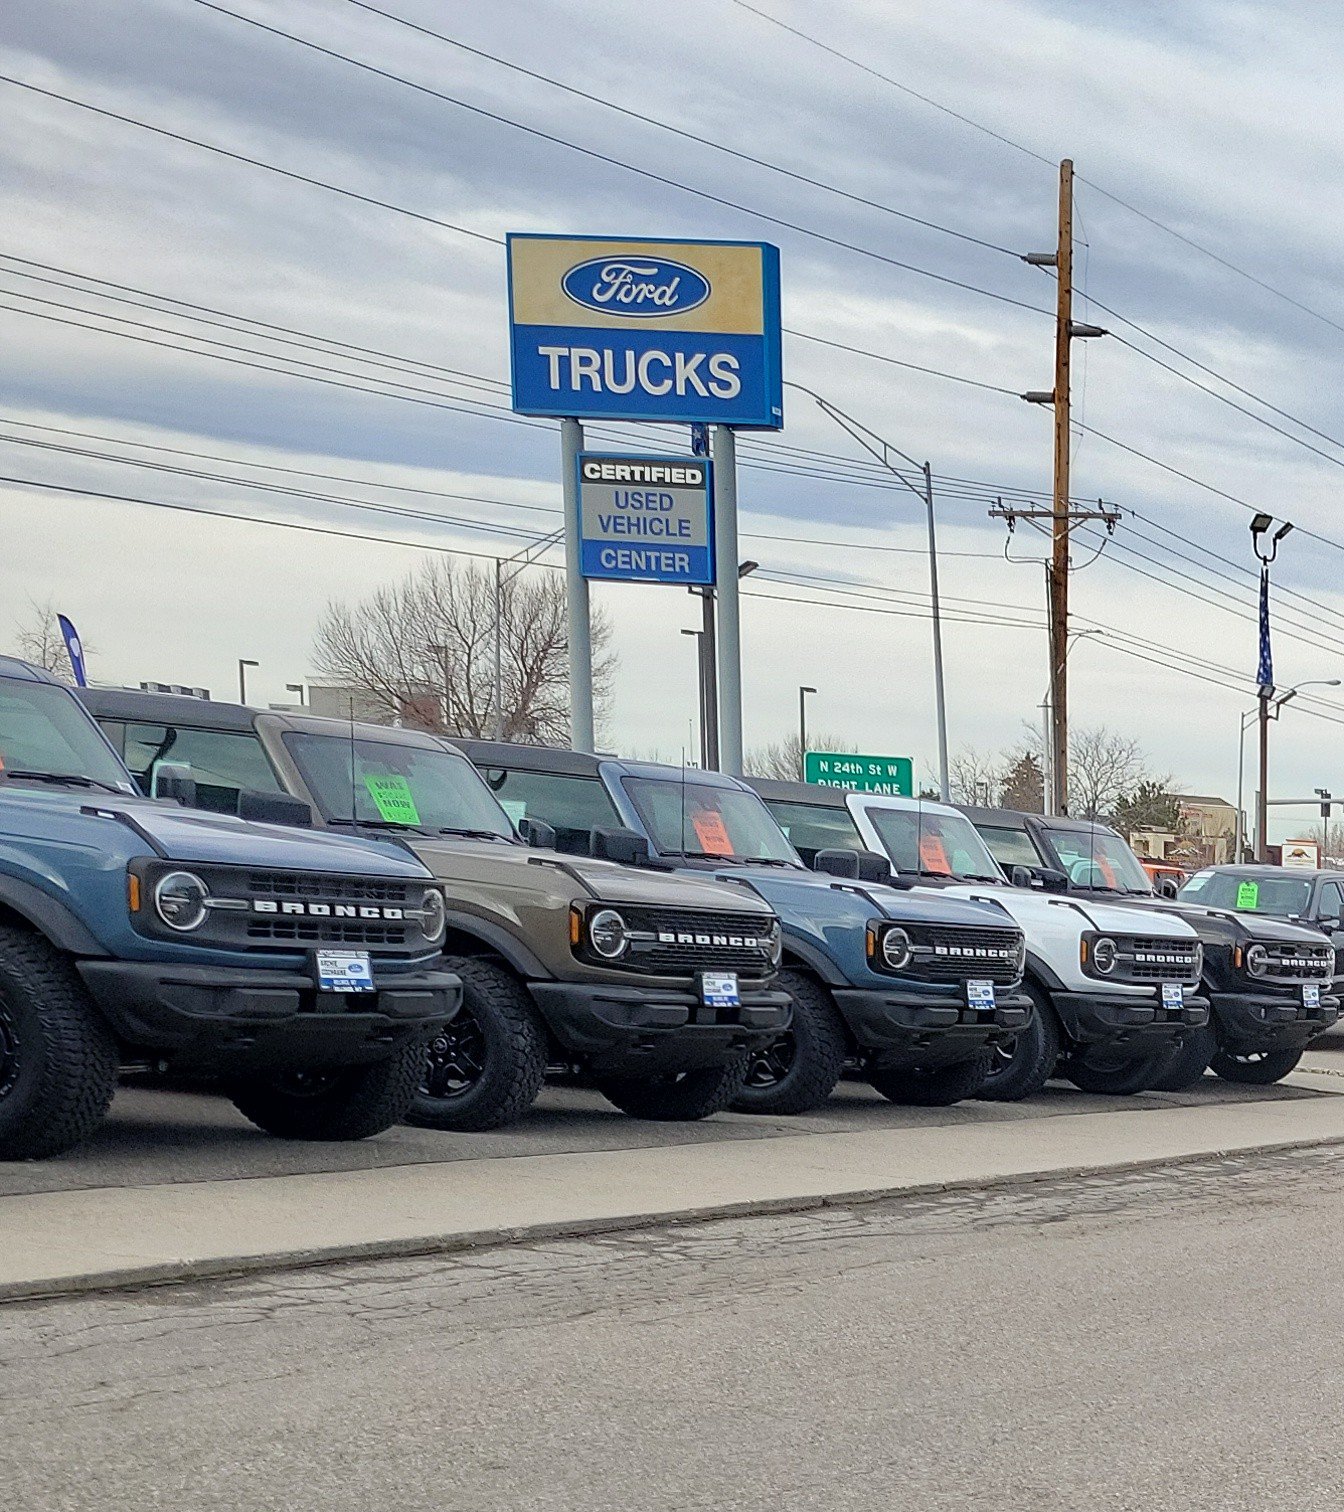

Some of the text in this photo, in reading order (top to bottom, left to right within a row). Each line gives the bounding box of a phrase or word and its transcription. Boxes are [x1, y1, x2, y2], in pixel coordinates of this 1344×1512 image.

[591, 262, 680, 307] Ford
[537, 345, 742, 400] TRUCKS
[583, 462, 702, 486] CERTIFIED
[614, 489, 674, 513] USED
[597, 513, 691, 539] VEHICLE
[600, 547, 690, 574] CENTER
[820, 760, 897, 776] N 24th St W
[864, 781, 901, 795] LANE
[254, 901, 403, 919] BRONCO
[658, 932, 758, 947] BRONCO
[934, 946, 1009, 958] BRONCO
[1135, 953, 1192, 964] BRONCO
